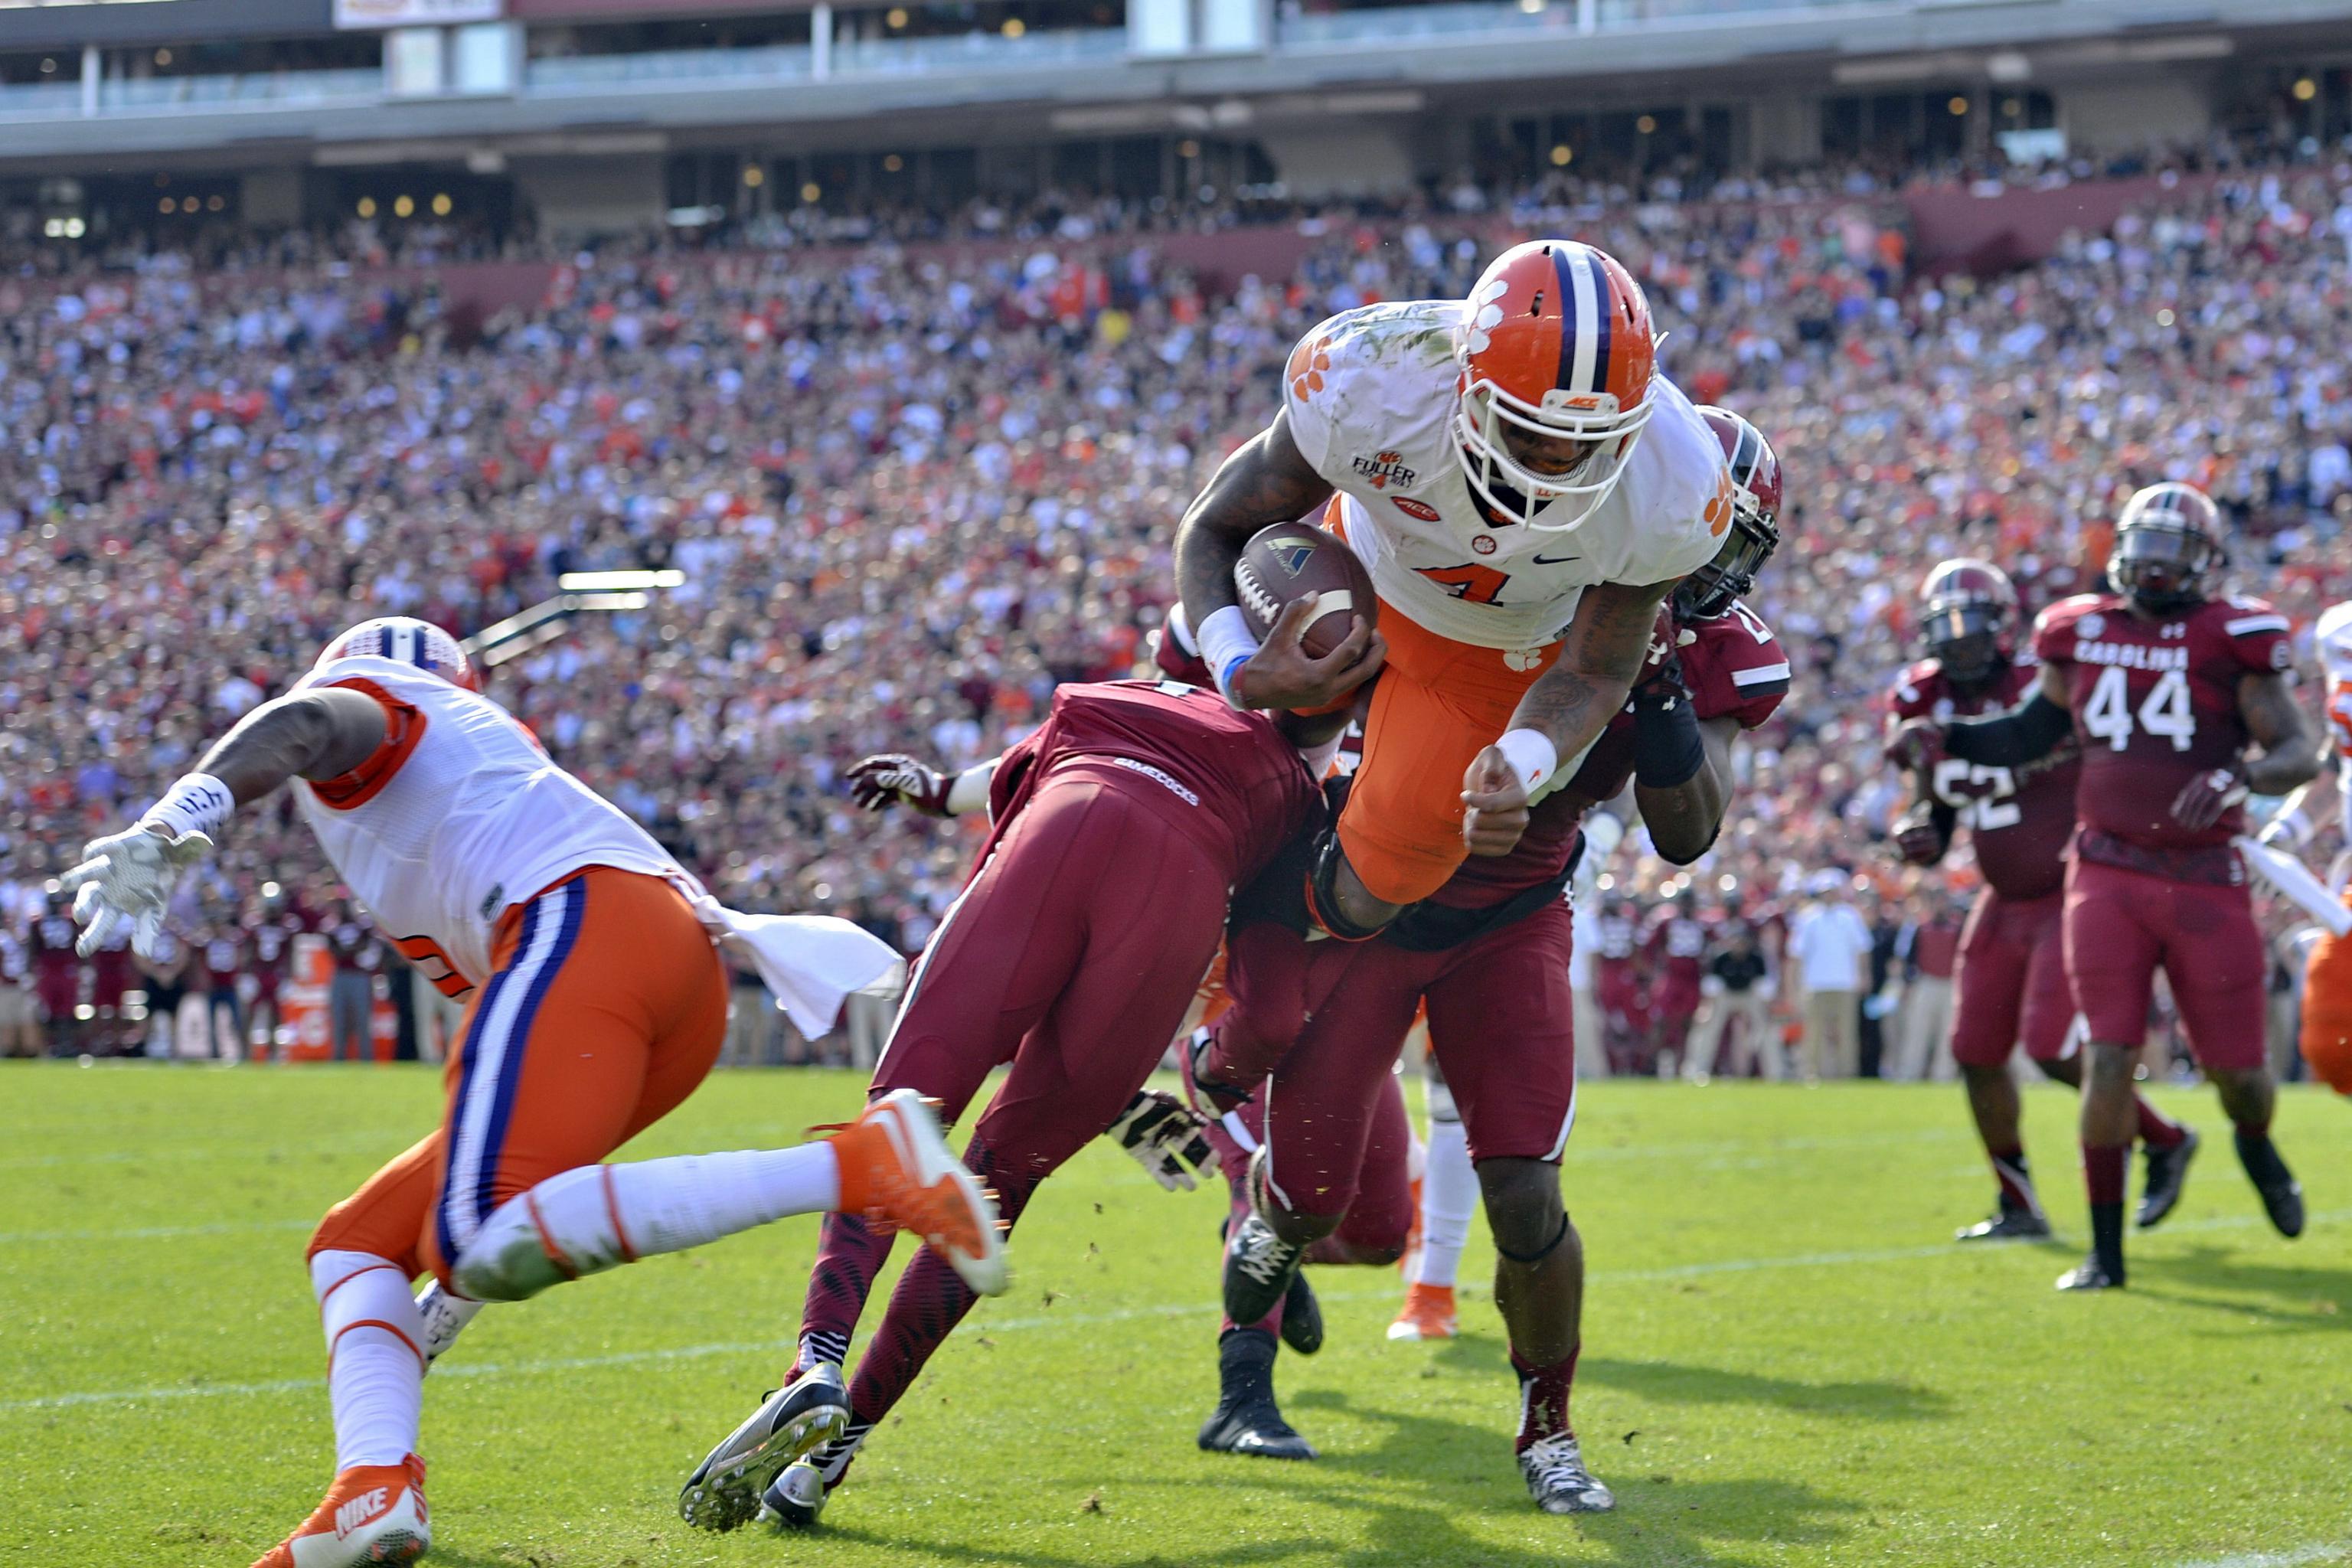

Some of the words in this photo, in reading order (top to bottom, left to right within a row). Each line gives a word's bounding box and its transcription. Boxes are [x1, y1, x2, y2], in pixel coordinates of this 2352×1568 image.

[1563, 396, 1601, 408] ACC
[1353, 456, 1415, 482] FULLER
[1410, 561, 1511, 607] 4
[2073, 639, 2190, 672] CAROLINA
[2082, 665, 2197, 752] 44
[1113, 757, 1200, 807] GAMECOCKS
[335, 1486, 388, 1542] NIKE
